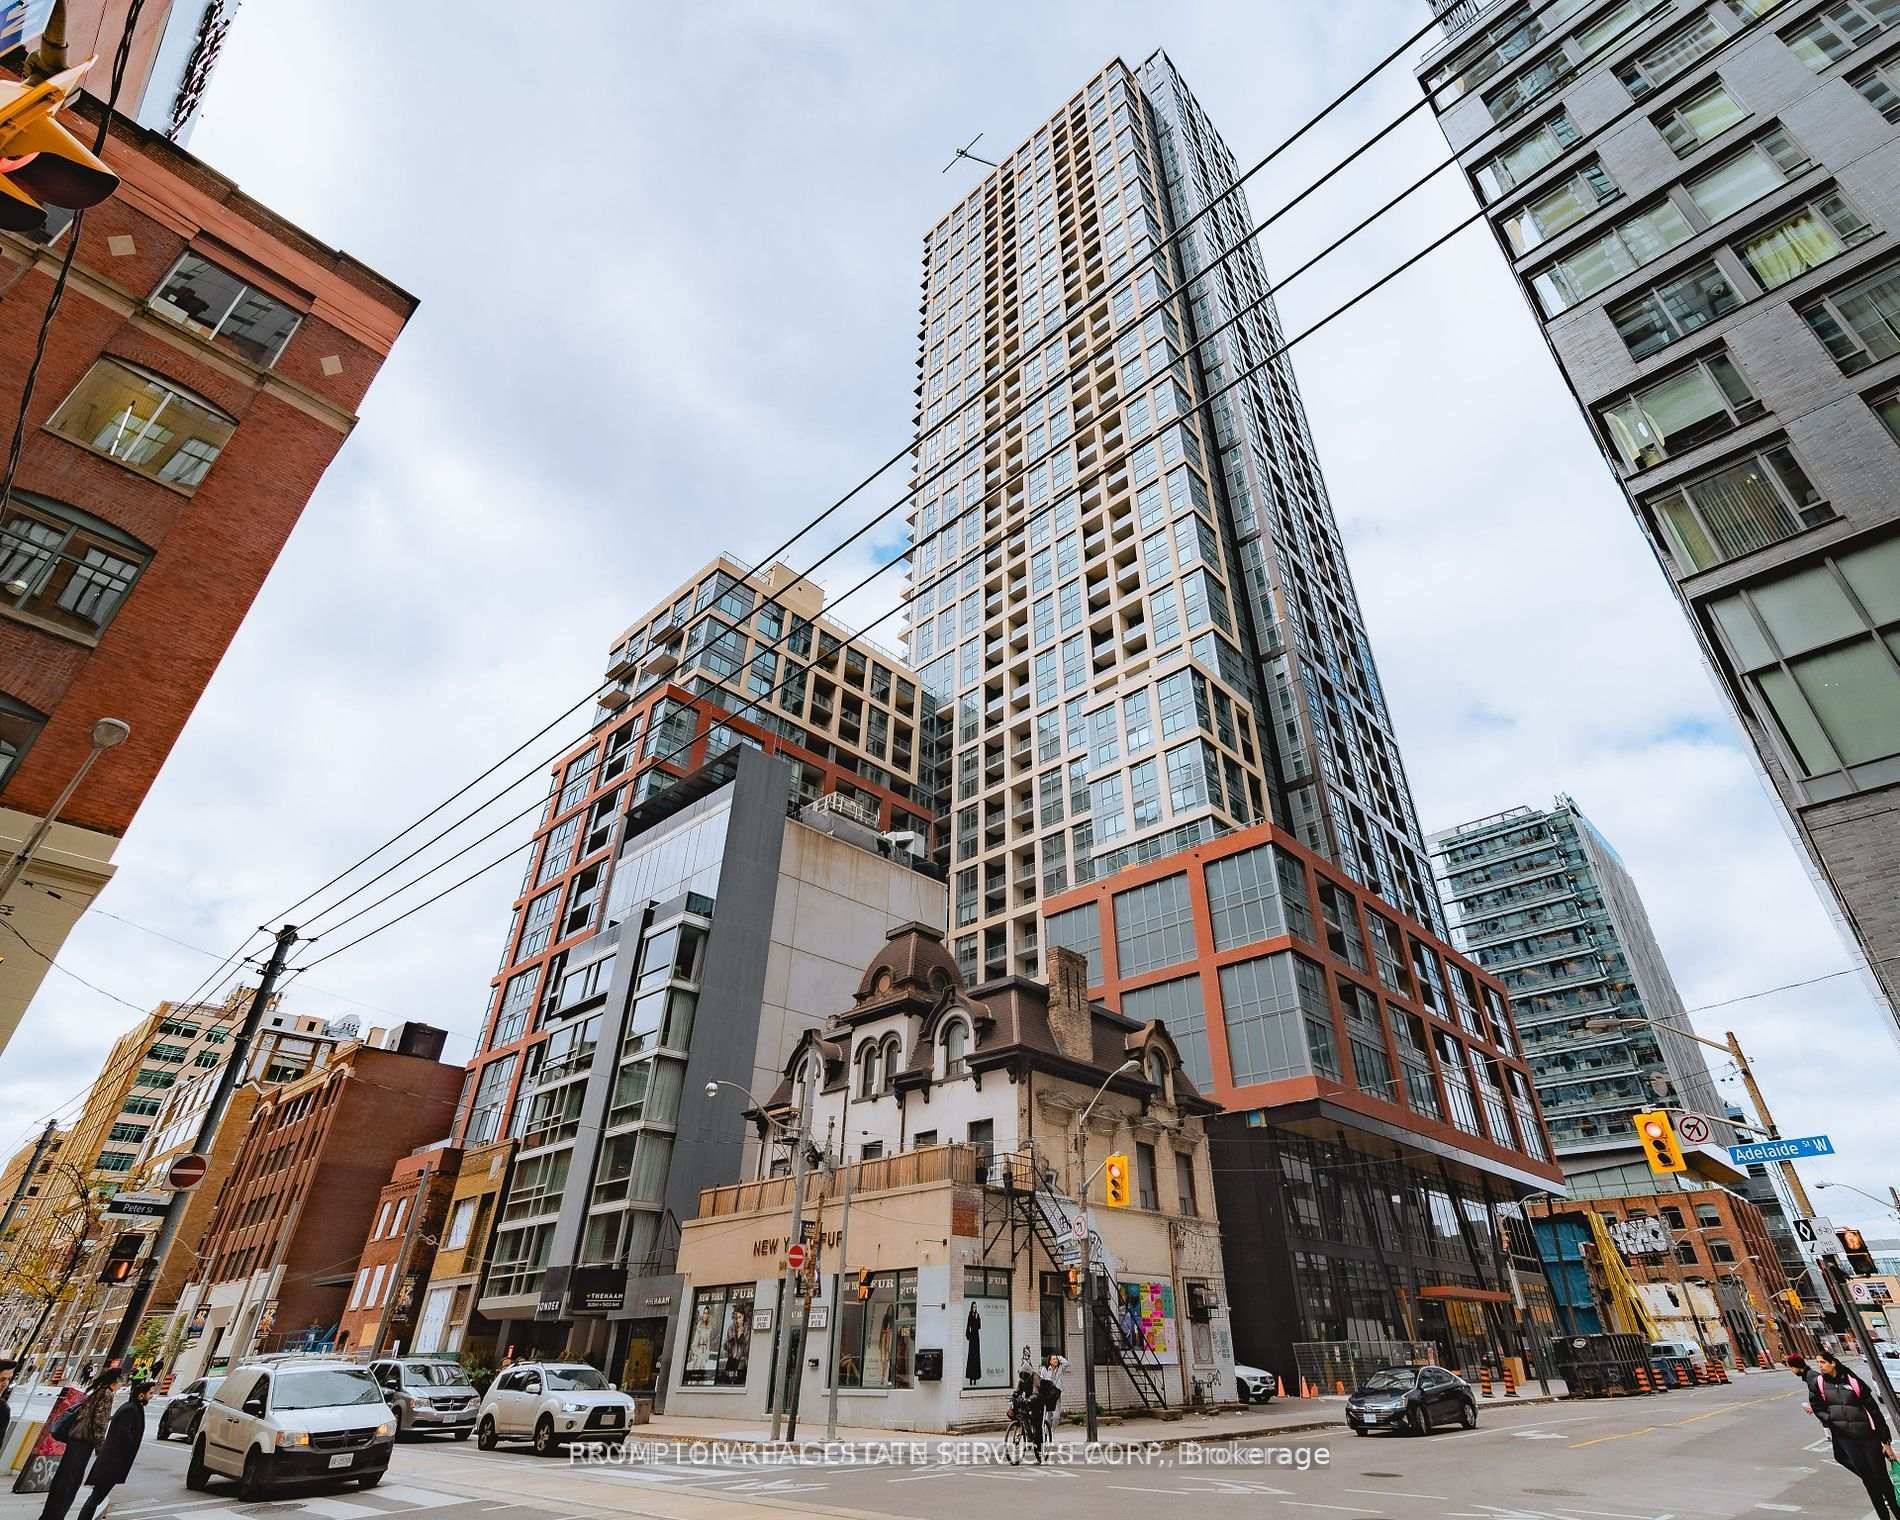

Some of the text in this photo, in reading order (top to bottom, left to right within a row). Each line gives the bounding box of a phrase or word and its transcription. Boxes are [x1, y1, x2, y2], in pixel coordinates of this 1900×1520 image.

[1735, 1143, 1799, 1161] Adelaide
[1813, 1137, 1828, 1152] W
[122, 1203, 146, 1213] Peter
[753, 1238, 779, 1257] NEW
[732, 1287, 755, 1300] FUR
